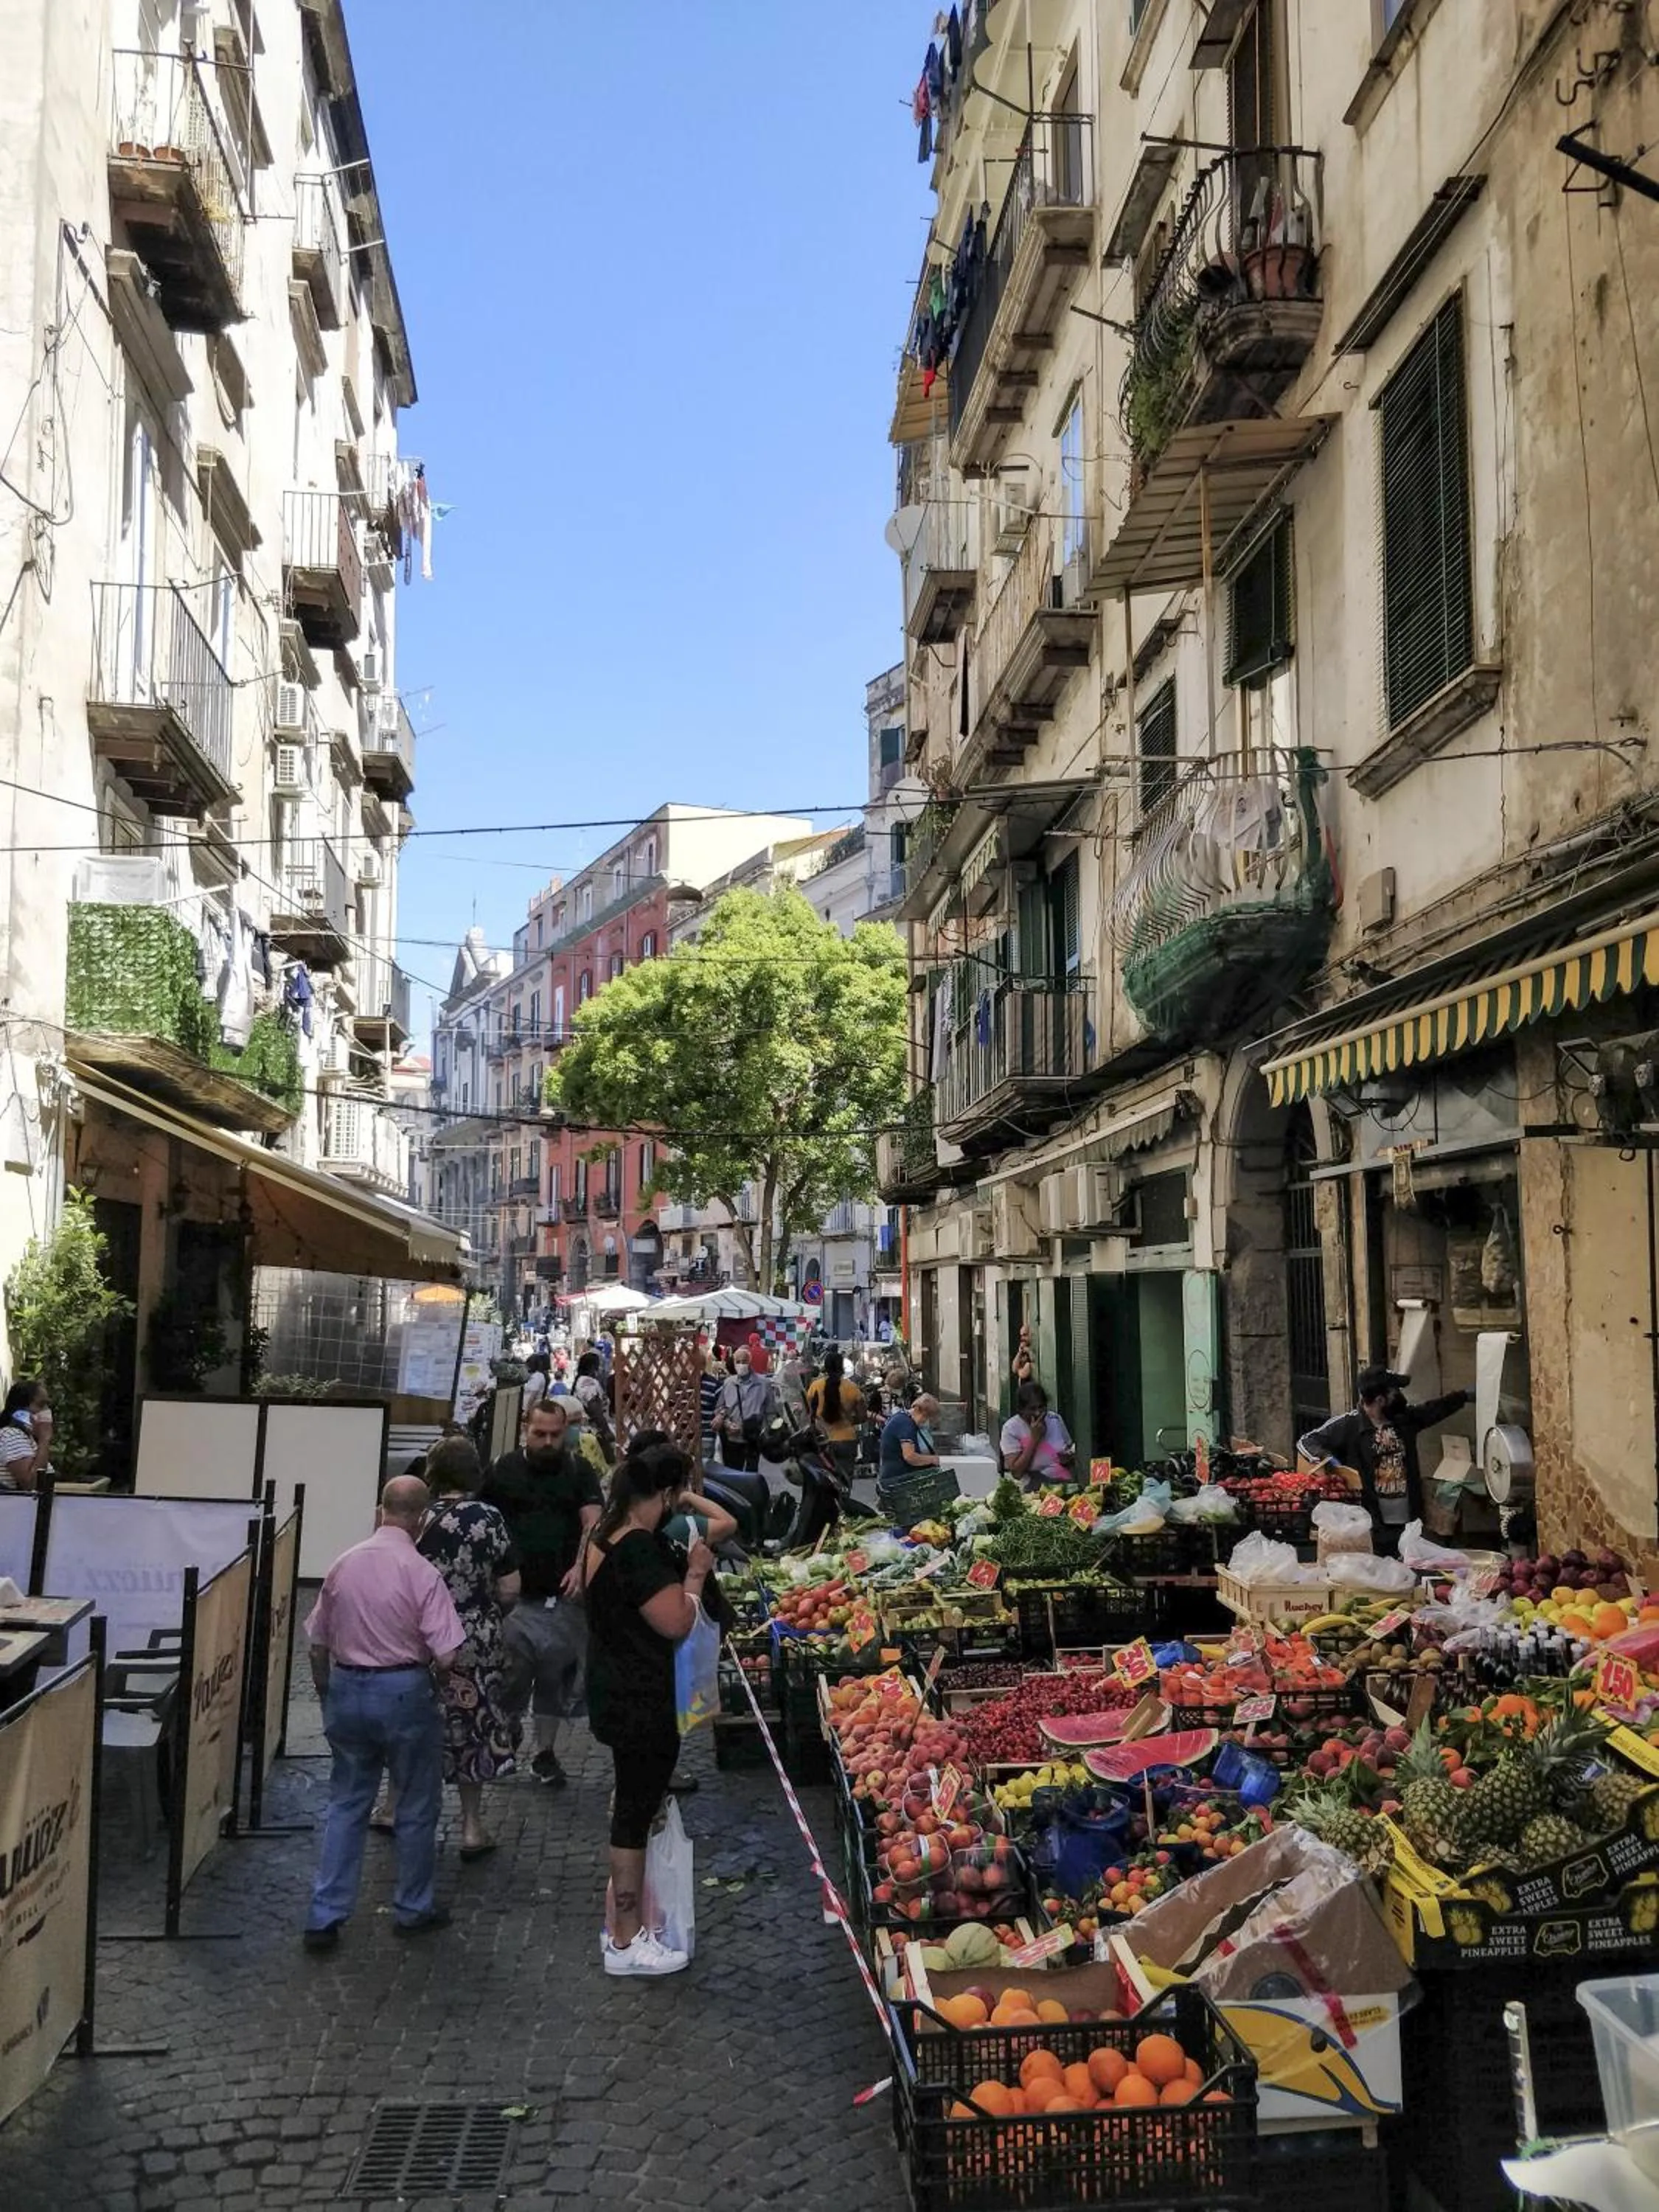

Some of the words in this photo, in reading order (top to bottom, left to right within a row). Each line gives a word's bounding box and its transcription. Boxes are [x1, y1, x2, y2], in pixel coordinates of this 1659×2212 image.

[1606, 1833, 1638, 1857] EXTRA
[1610, 1841, 1643, 1866] SWEET
[1614, 1844, 1659, 1876] PINEAPPL
[1516, 1876, 1551, 1895] EXTRA
[1519, 1885, 1554, 1907] SWEET
[1491, 1925, 1527, 1935] EXTRA
[1587, 1916, 1621, 1928] EXTRA
[1488, 1935, 1526, 1946] SWEET
[1587, 1927, 1624, 1938] SWEET
[1587, 1934, 1652, 1950] PINEAPPLES
[1460, 1945, 1527, 1958] PINEAPPLES
